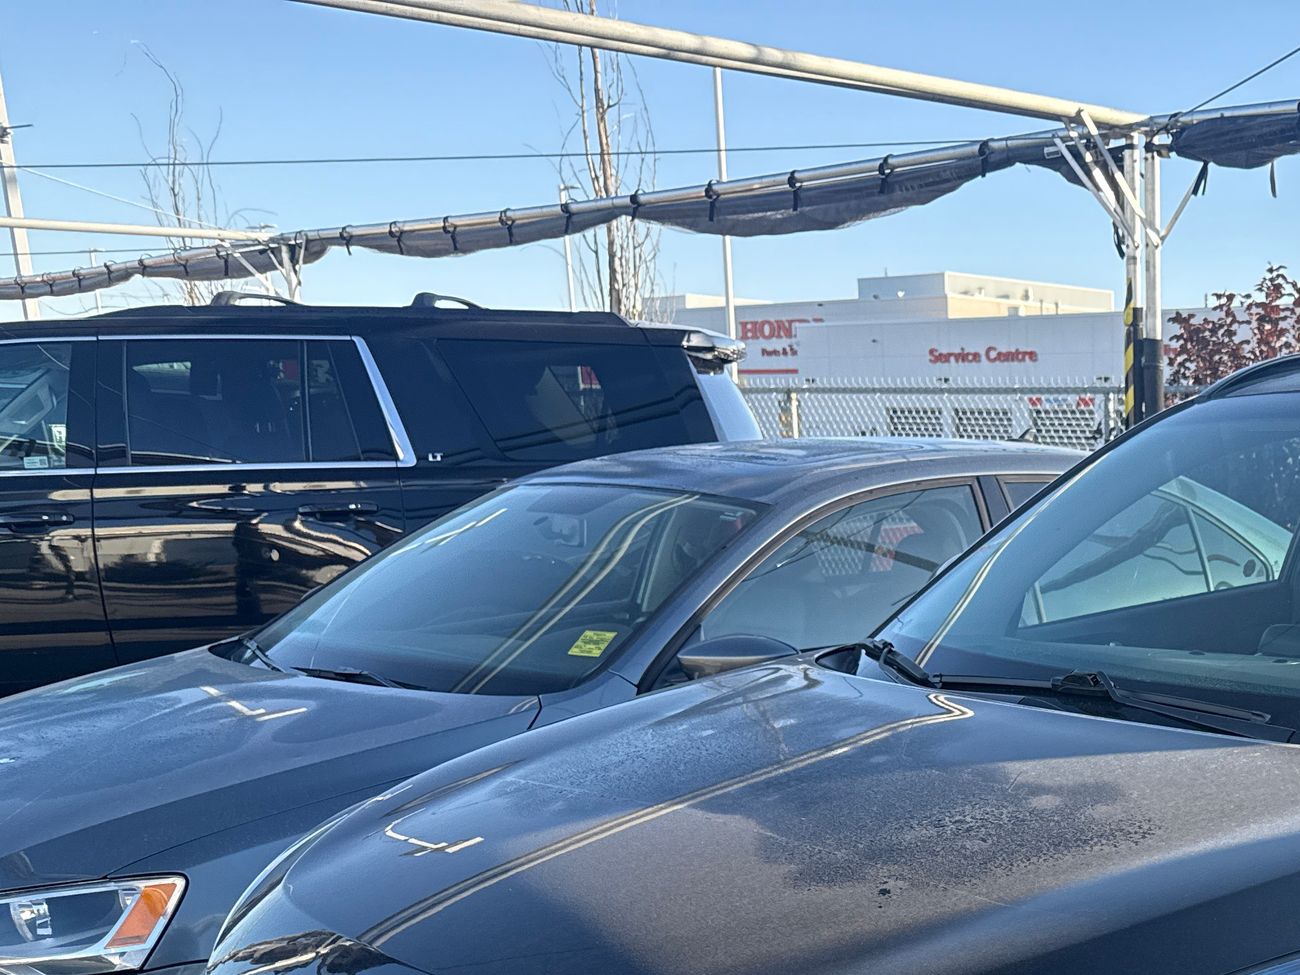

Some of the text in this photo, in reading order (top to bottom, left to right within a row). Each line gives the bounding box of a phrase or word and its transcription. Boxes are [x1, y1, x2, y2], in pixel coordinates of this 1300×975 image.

[740, 318, 824, 340] HON
[928, 346, 1038, 364] Service Centre
[428, 452, 443, 462] LT
